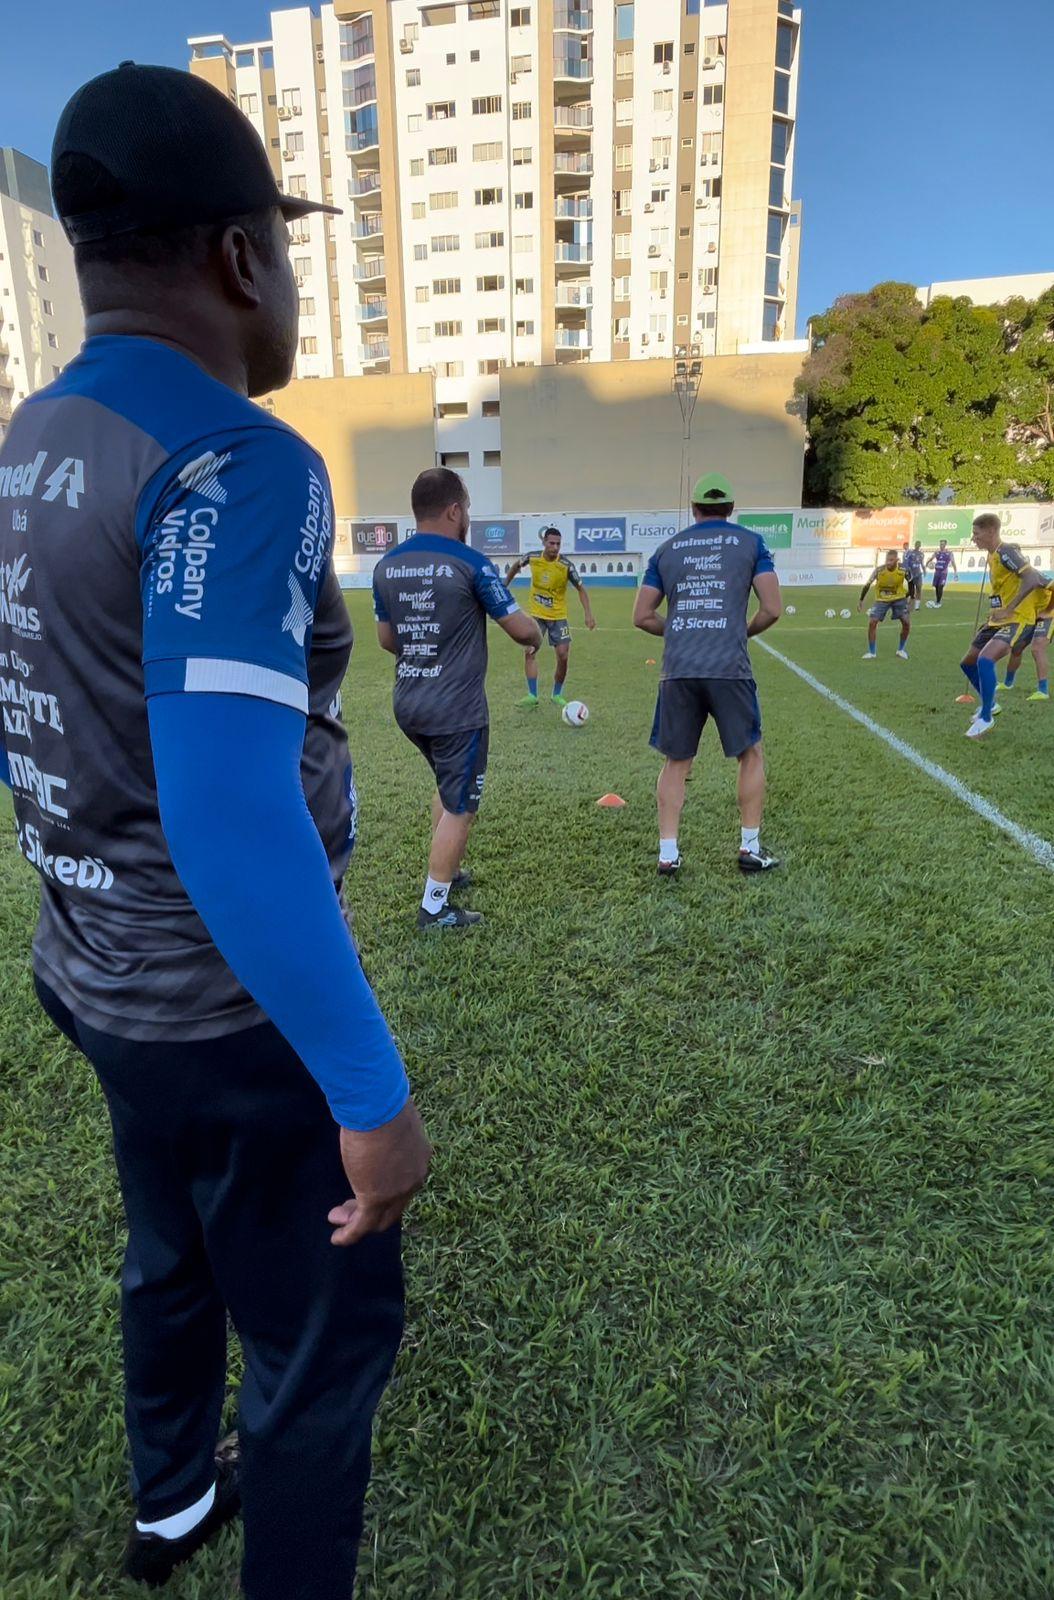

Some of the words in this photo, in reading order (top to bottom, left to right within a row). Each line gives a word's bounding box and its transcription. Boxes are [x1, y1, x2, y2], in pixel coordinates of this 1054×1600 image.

[12, 509, 28, 532] Ubá
[294, 468, 323, 574] Colpany
[797, 517, 825, 528] Mart
[577, 527, 622, 542] ROTA
[631, 524, 676, 536] Fusaro
[672, 535, 723, 550] Unimed
[156, 508, 187, 595] Vidros
[175, 507, 218, 620] Colpany
[386, 564, 434, 579] Unimed
[677, 581, 726, 593] DIAMANTE
[689, 588, 710, 596] AZUL
[686, 618, 727, 629] Sicredi
